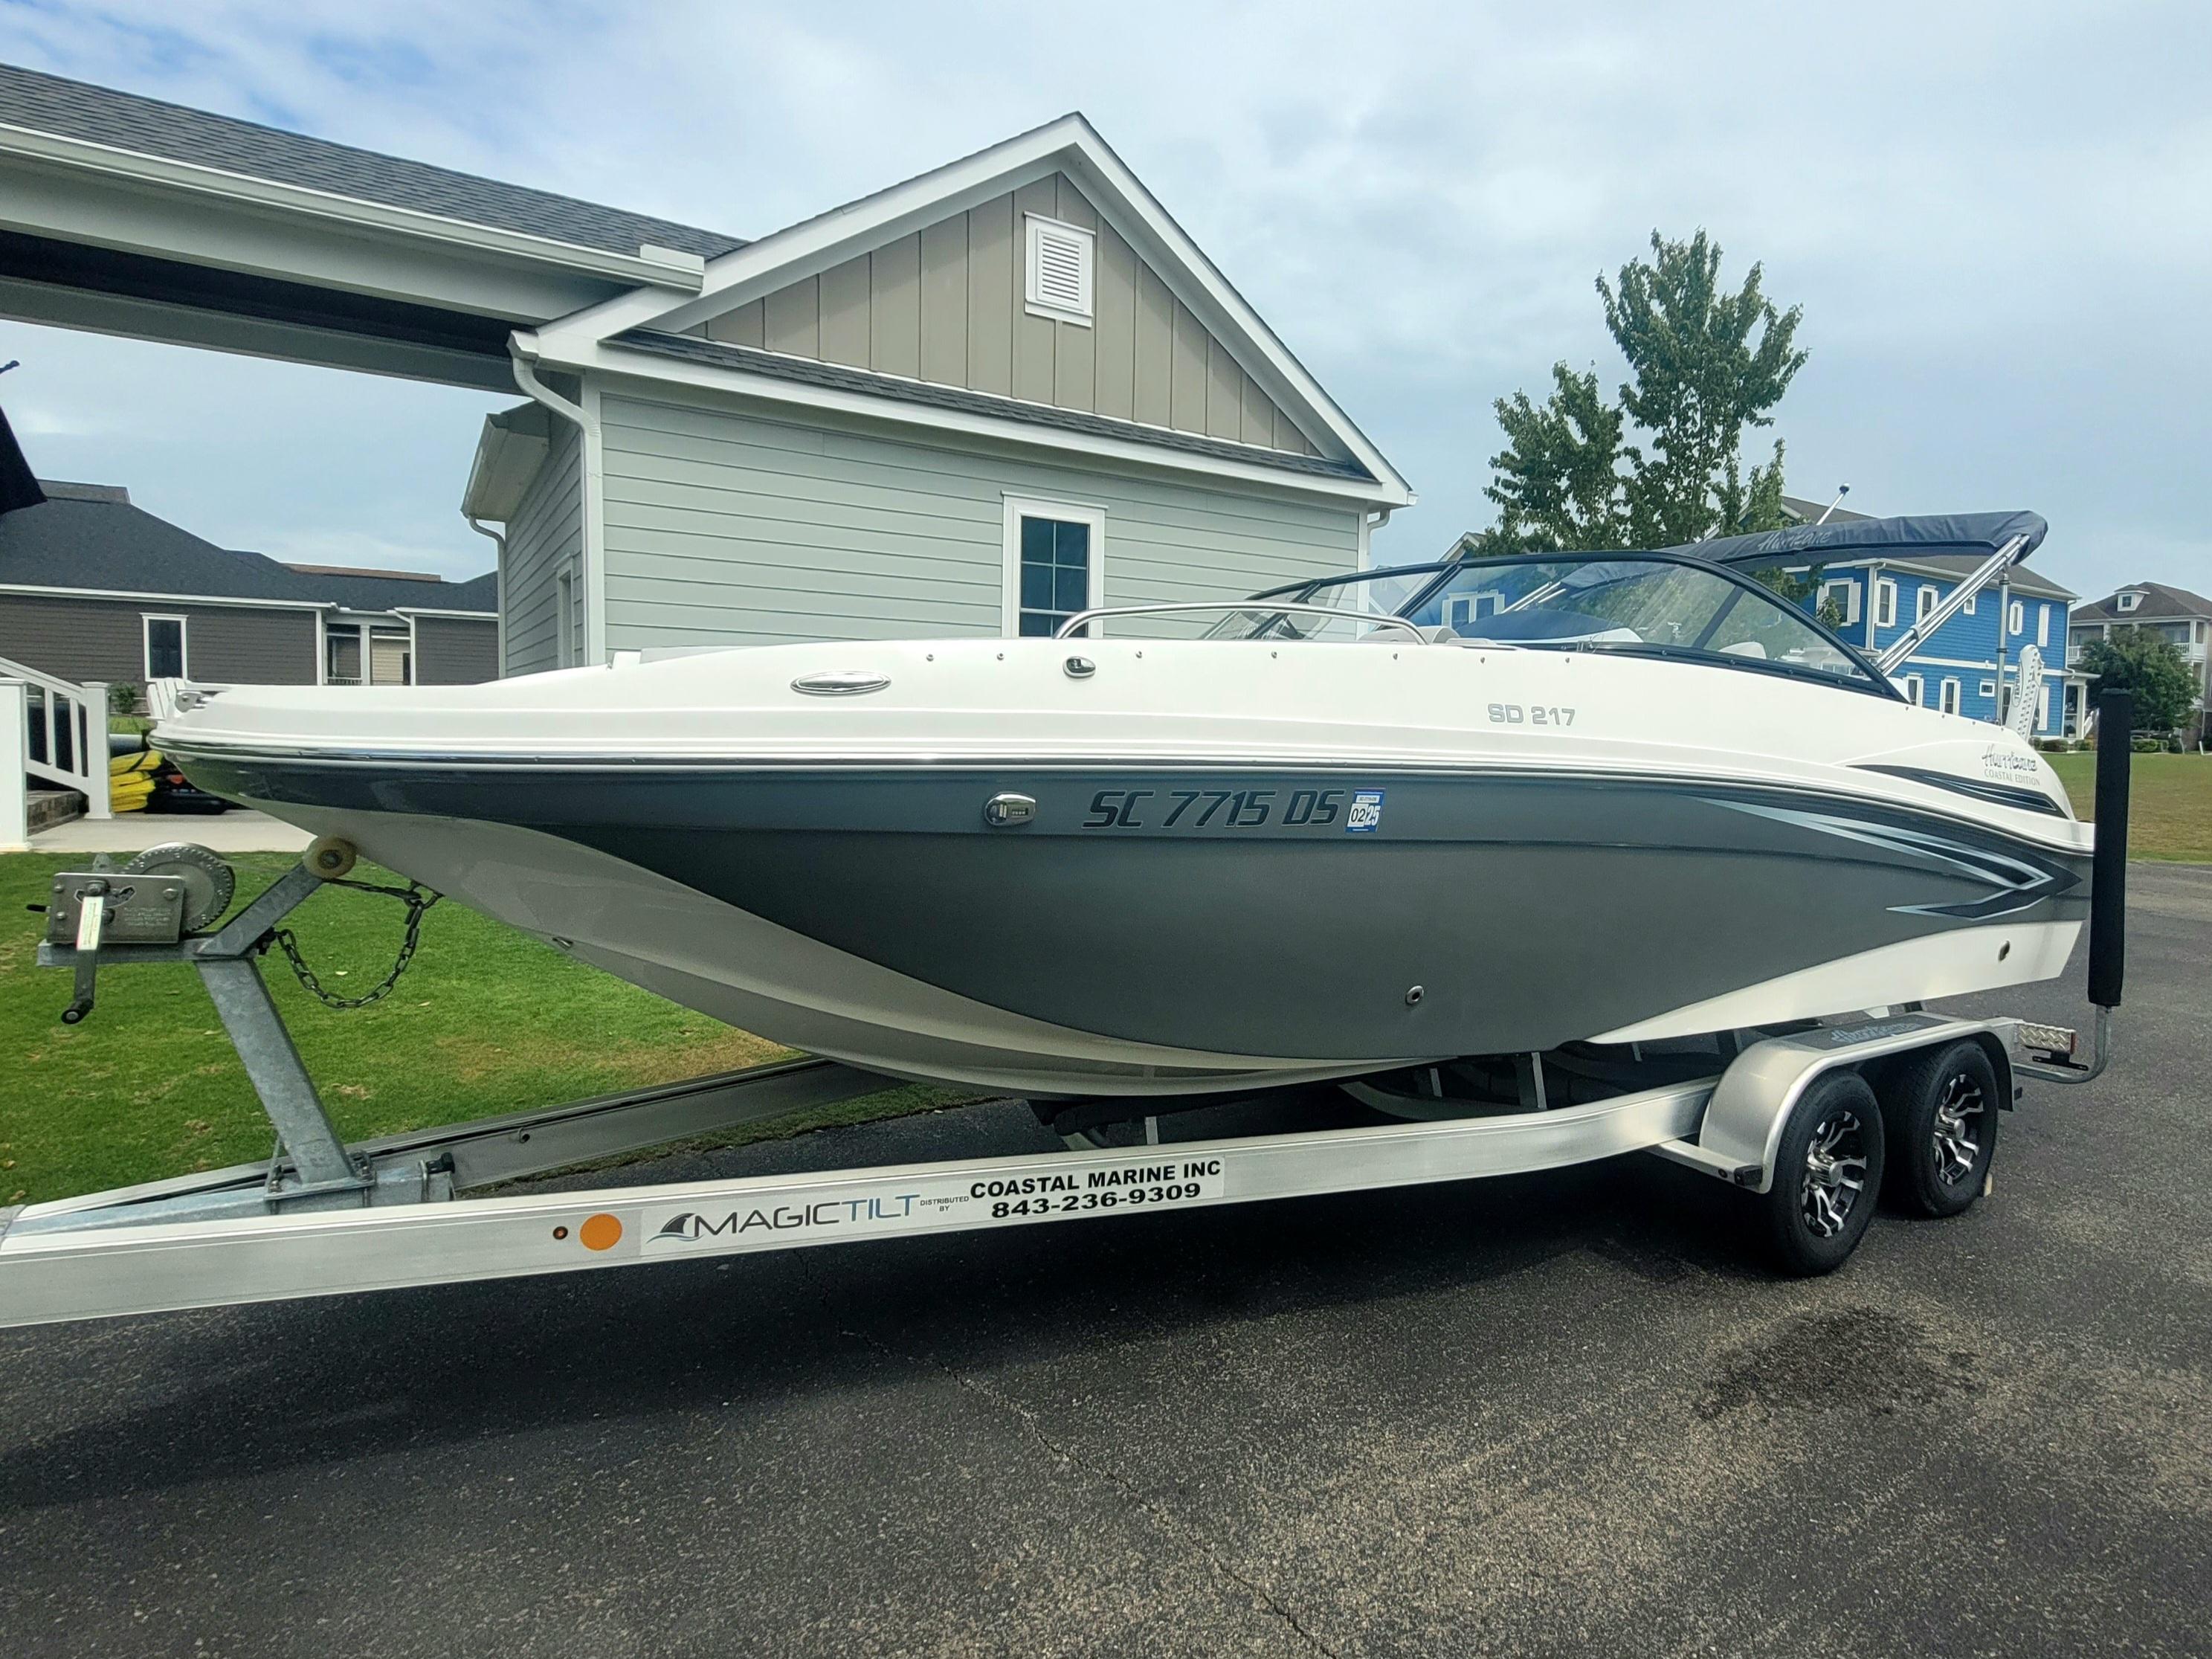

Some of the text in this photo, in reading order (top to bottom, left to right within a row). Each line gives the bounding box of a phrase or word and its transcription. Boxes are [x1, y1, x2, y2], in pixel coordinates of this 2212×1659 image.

[1487, 703, 1576, 727] SD 217
[1982, 744, 2037, 772] Hurricane
[1984, 768, 2040, 787] COASTAL EDITION
[1082, 790, 1155, 828] SC
[1161, 790, 1277, 828] 7715
[1350, 805, 1381, 826] 02 25
[970, 1160, 1221, 1199] COASTAL MARINE INC
[920, 1195, 970, 1206] DISTRIBUTED
[991, 1182, 1201, 1219] 843-236-9309
[694, 1193, 920, 1237] MAGICTILT
